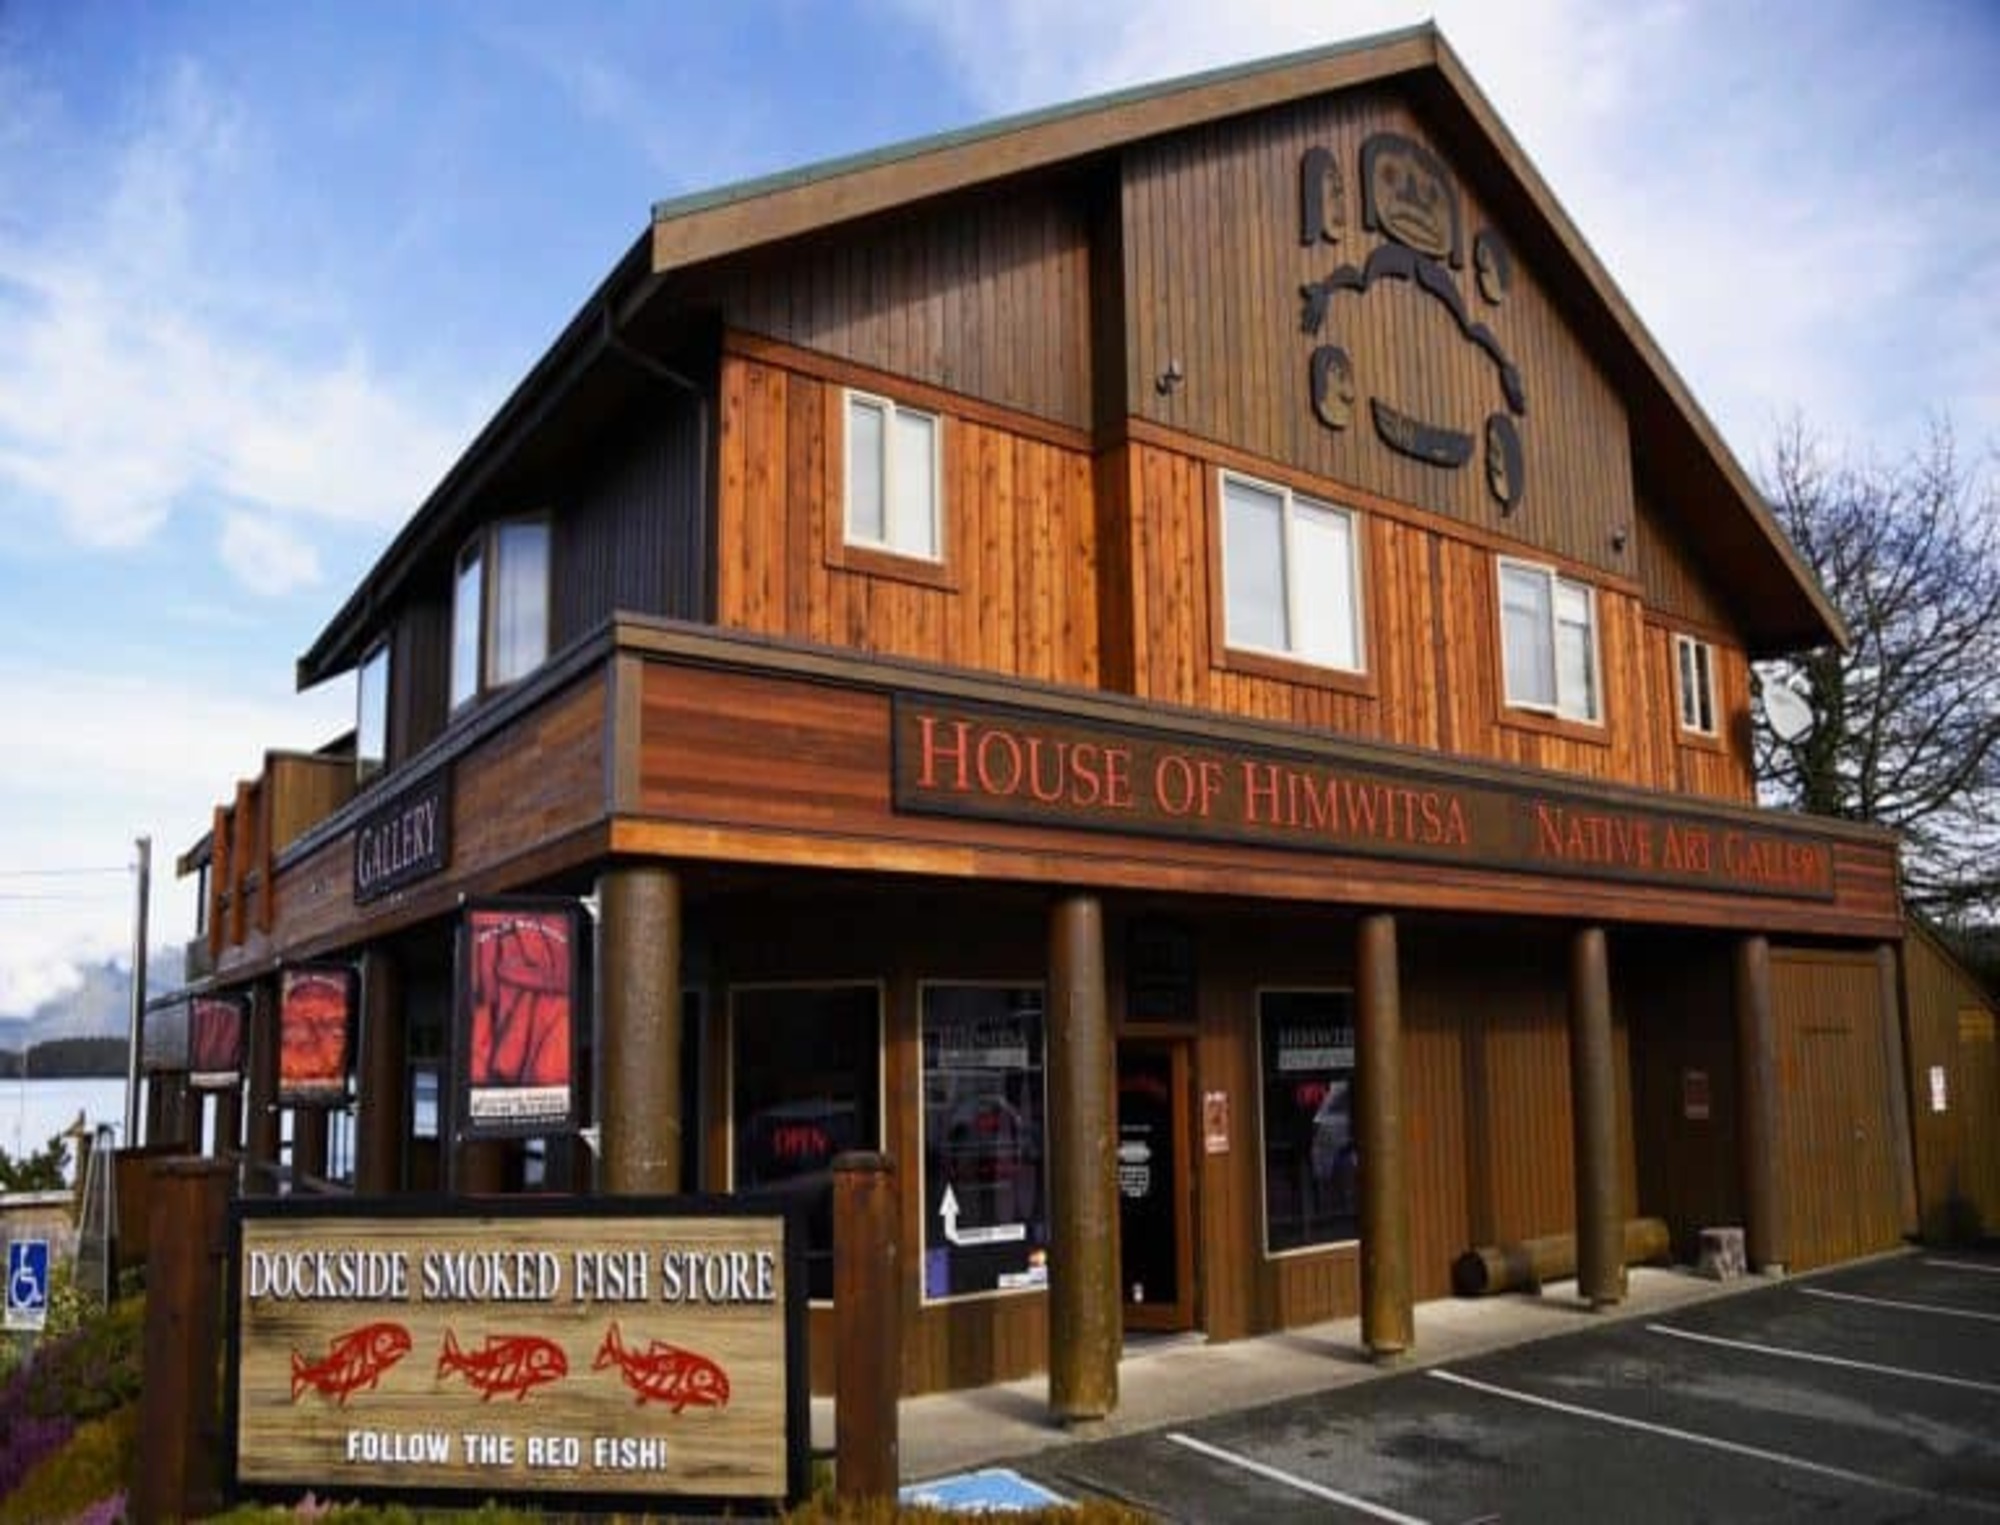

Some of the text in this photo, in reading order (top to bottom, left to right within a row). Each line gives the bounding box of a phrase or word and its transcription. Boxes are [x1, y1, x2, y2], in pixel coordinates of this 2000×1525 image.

[916, 715, 1470, 846] HOUSE OF HIMWITSA
[358, 795, 439, 888] GALLERY
[1536, 803, 1652, 869] NATIVE
[1662, 822, 1711, 873] ART
[248, 1249, 778, 1303] DOCKSIDE SMOKED FISH STORE
[346, 1430, 669, 1470] FOLLOW THE RED FISH!
